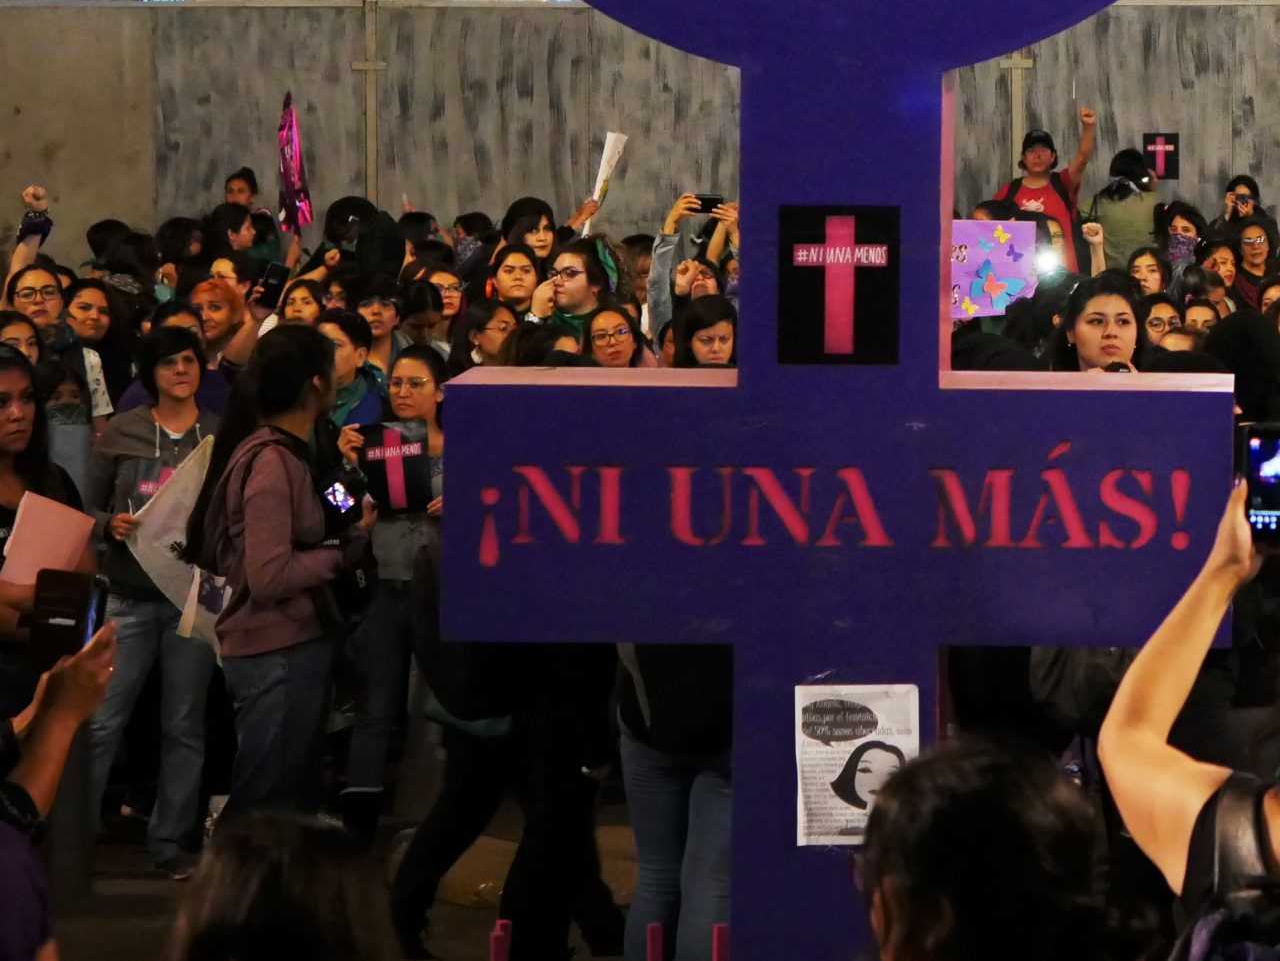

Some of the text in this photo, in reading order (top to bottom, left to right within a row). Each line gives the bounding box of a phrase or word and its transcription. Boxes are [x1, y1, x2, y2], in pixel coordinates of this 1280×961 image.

[854, 246, 888, 264] MENOS
[478, 441, 1192, 567] ¡NI UNA MÁS!
